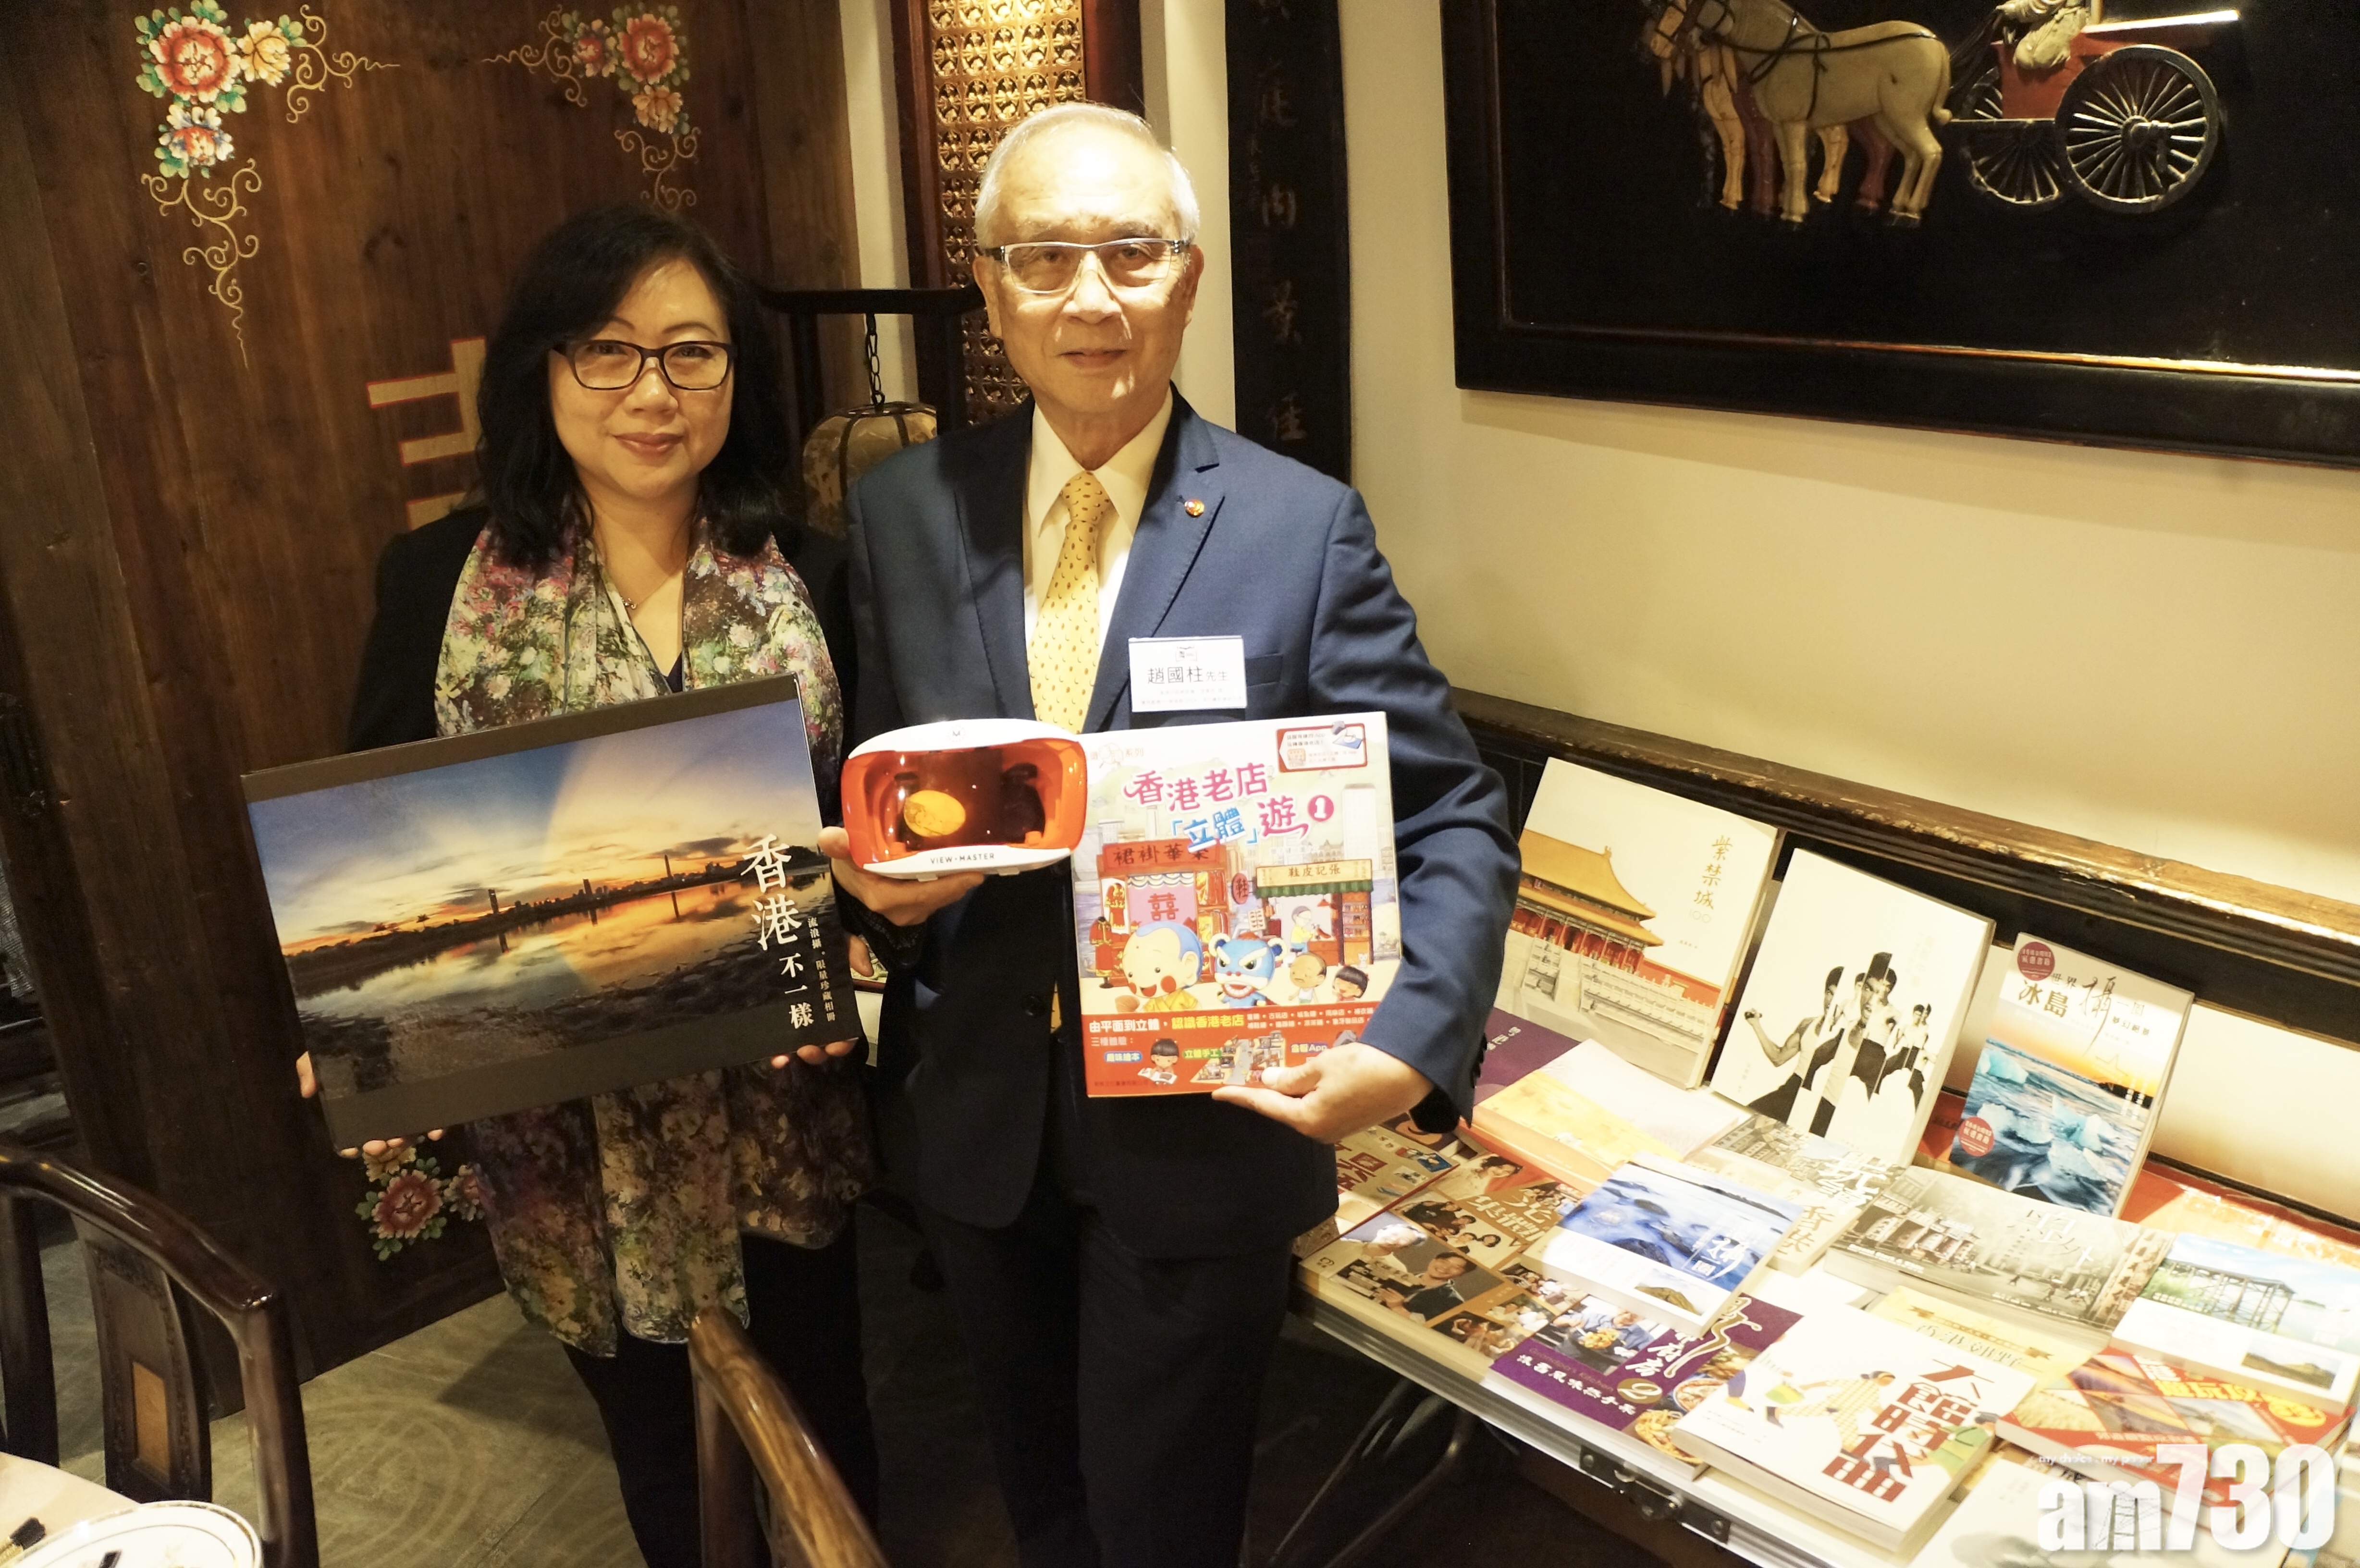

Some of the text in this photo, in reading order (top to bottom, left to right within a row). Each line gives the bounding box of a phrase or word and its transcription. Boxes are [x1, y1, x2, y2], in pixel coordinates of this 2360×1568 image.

[1123, 763, 1268, 811] 香港老店
[1693, 834, 1733, 910] 紫禁城
[740, 833, 815, 1029] 香港不一樣
[2018, 980, 2069, 1018] 冰島
